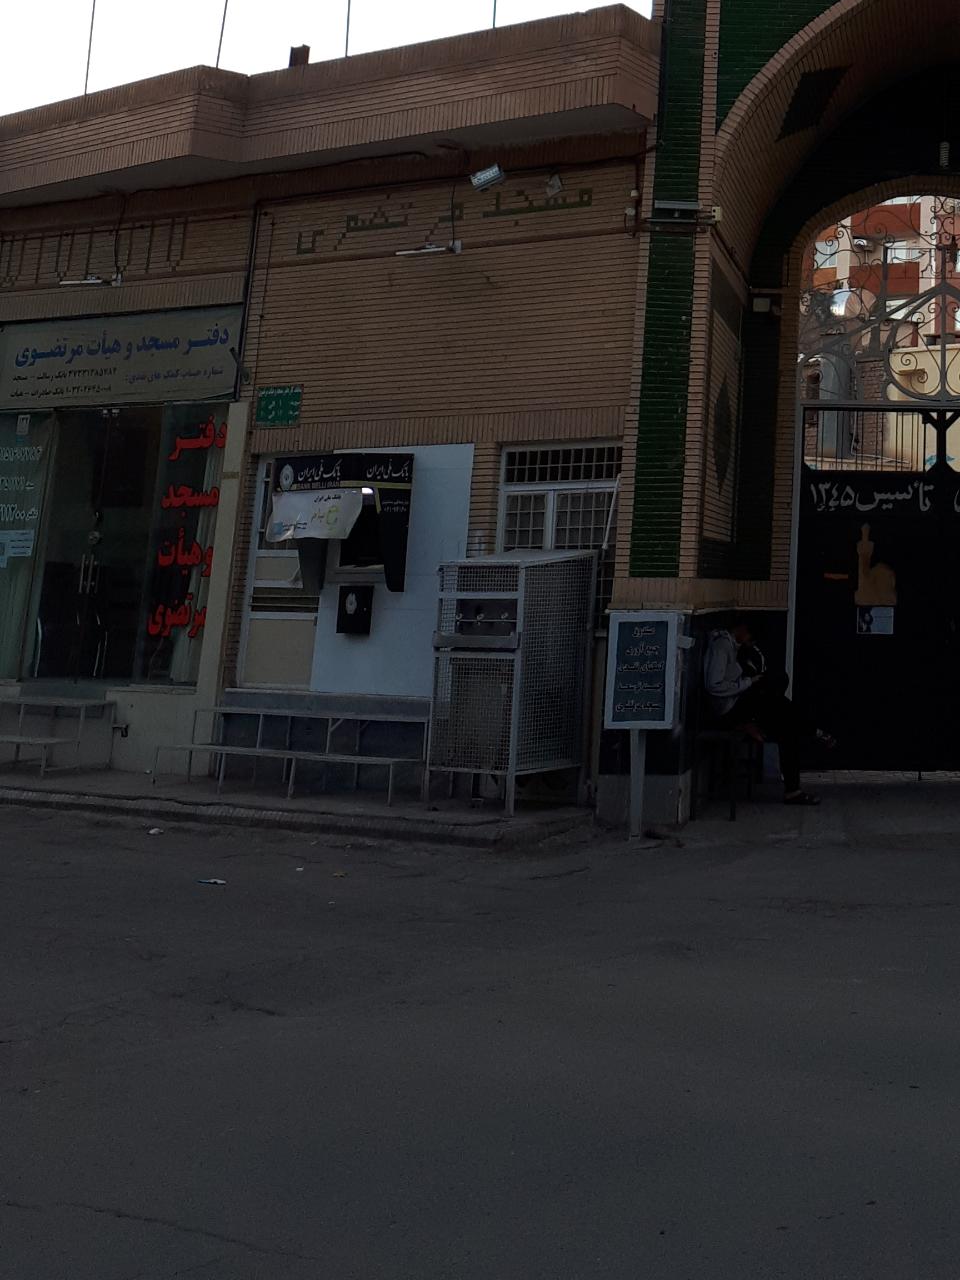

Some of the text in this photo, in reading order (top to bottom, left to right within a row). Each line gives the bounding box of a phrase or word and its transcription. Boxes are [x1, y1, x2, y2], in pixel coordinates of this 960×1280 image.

[15, 337, 83, 368] مرتضوی
[124, 341, 132, 360] و
[137, 335, 180, 362] مسجد
[183, 323, 229, 355] دفتر
[168, 415, 227, 461] دفتر
[298, 466, 315, 482] ایران
[367, 463, 384, 480] ایران
[161, 484, 220, 518] مسجد
[202, 545, 213, 577] و
